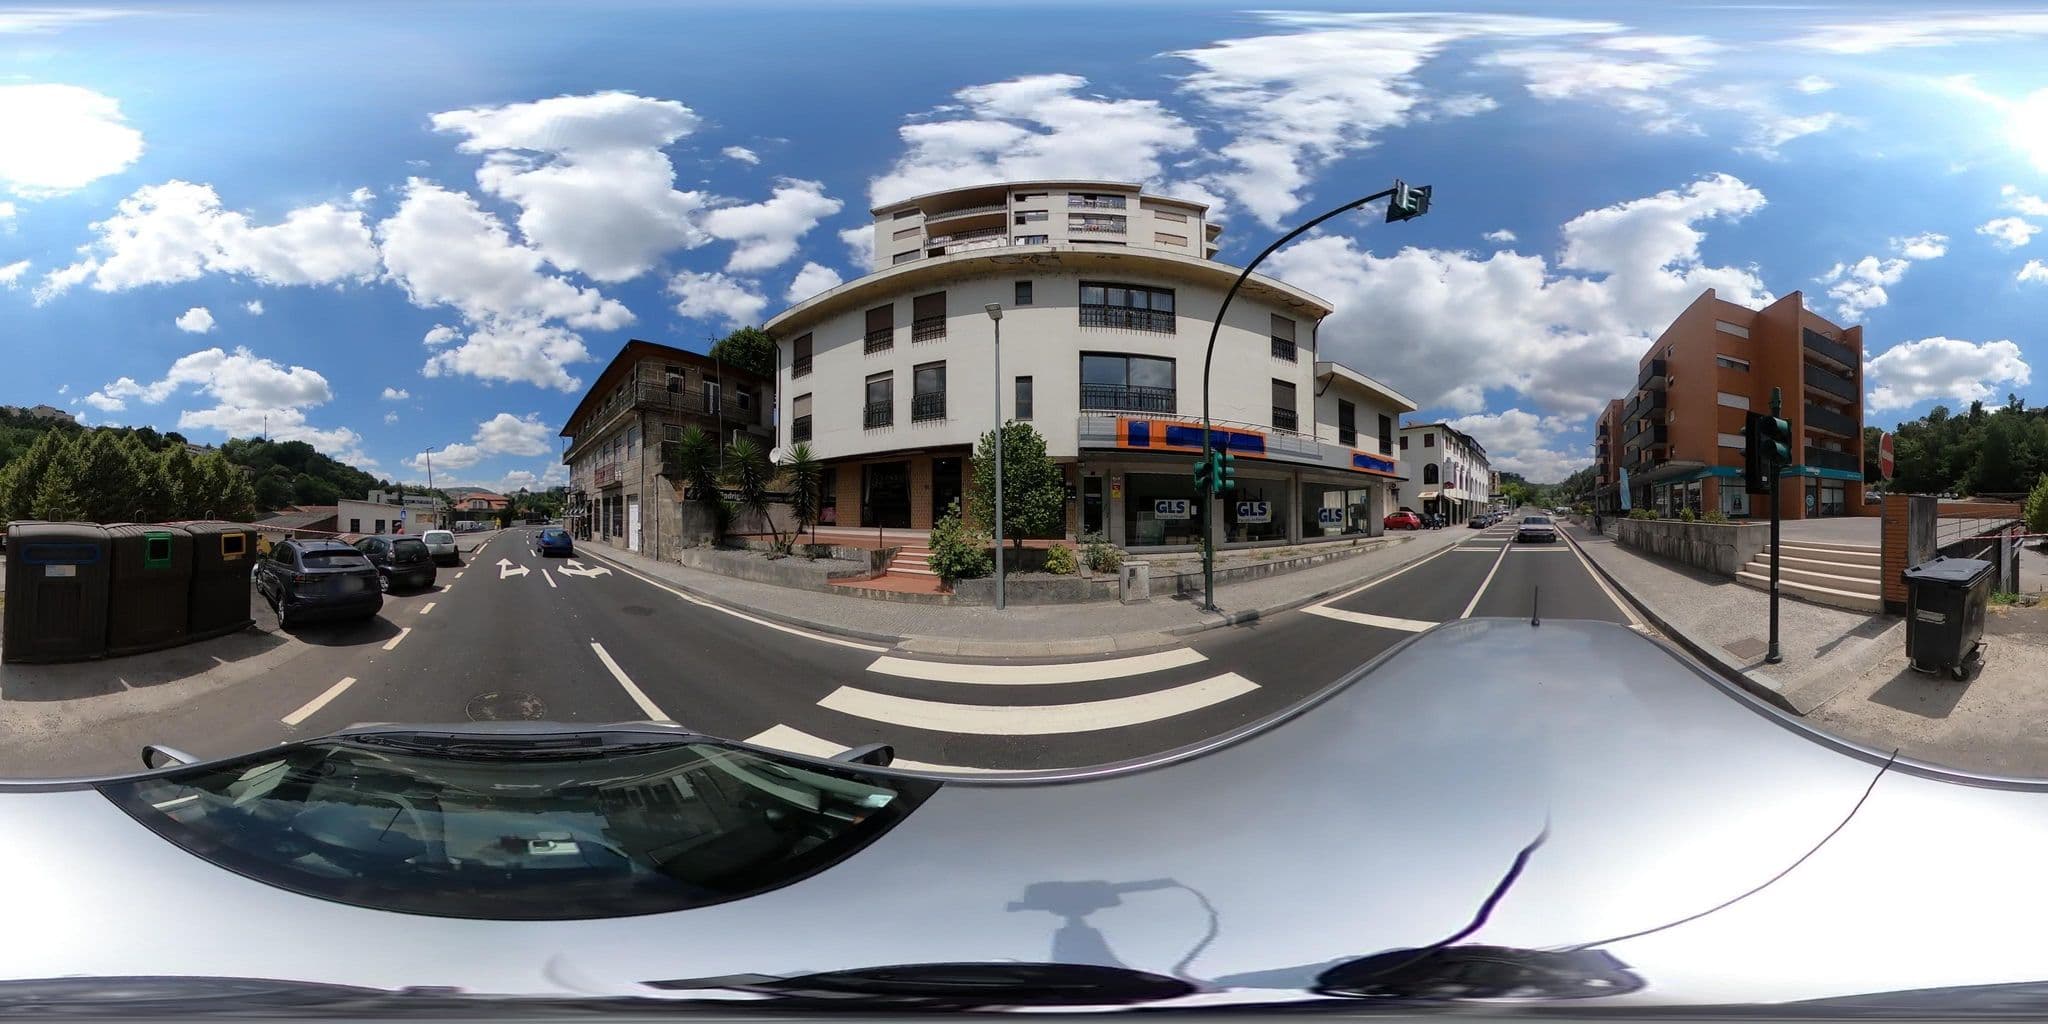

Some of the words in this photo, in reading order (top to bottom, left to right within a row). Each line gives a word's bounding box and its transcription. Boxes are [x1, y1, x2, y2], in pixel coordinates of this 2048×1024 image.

[1156, 501, 1185, 513] GLS
[1238, 502, 1267, 516] GLS
[1319, 509, 1343, 522] GLS
